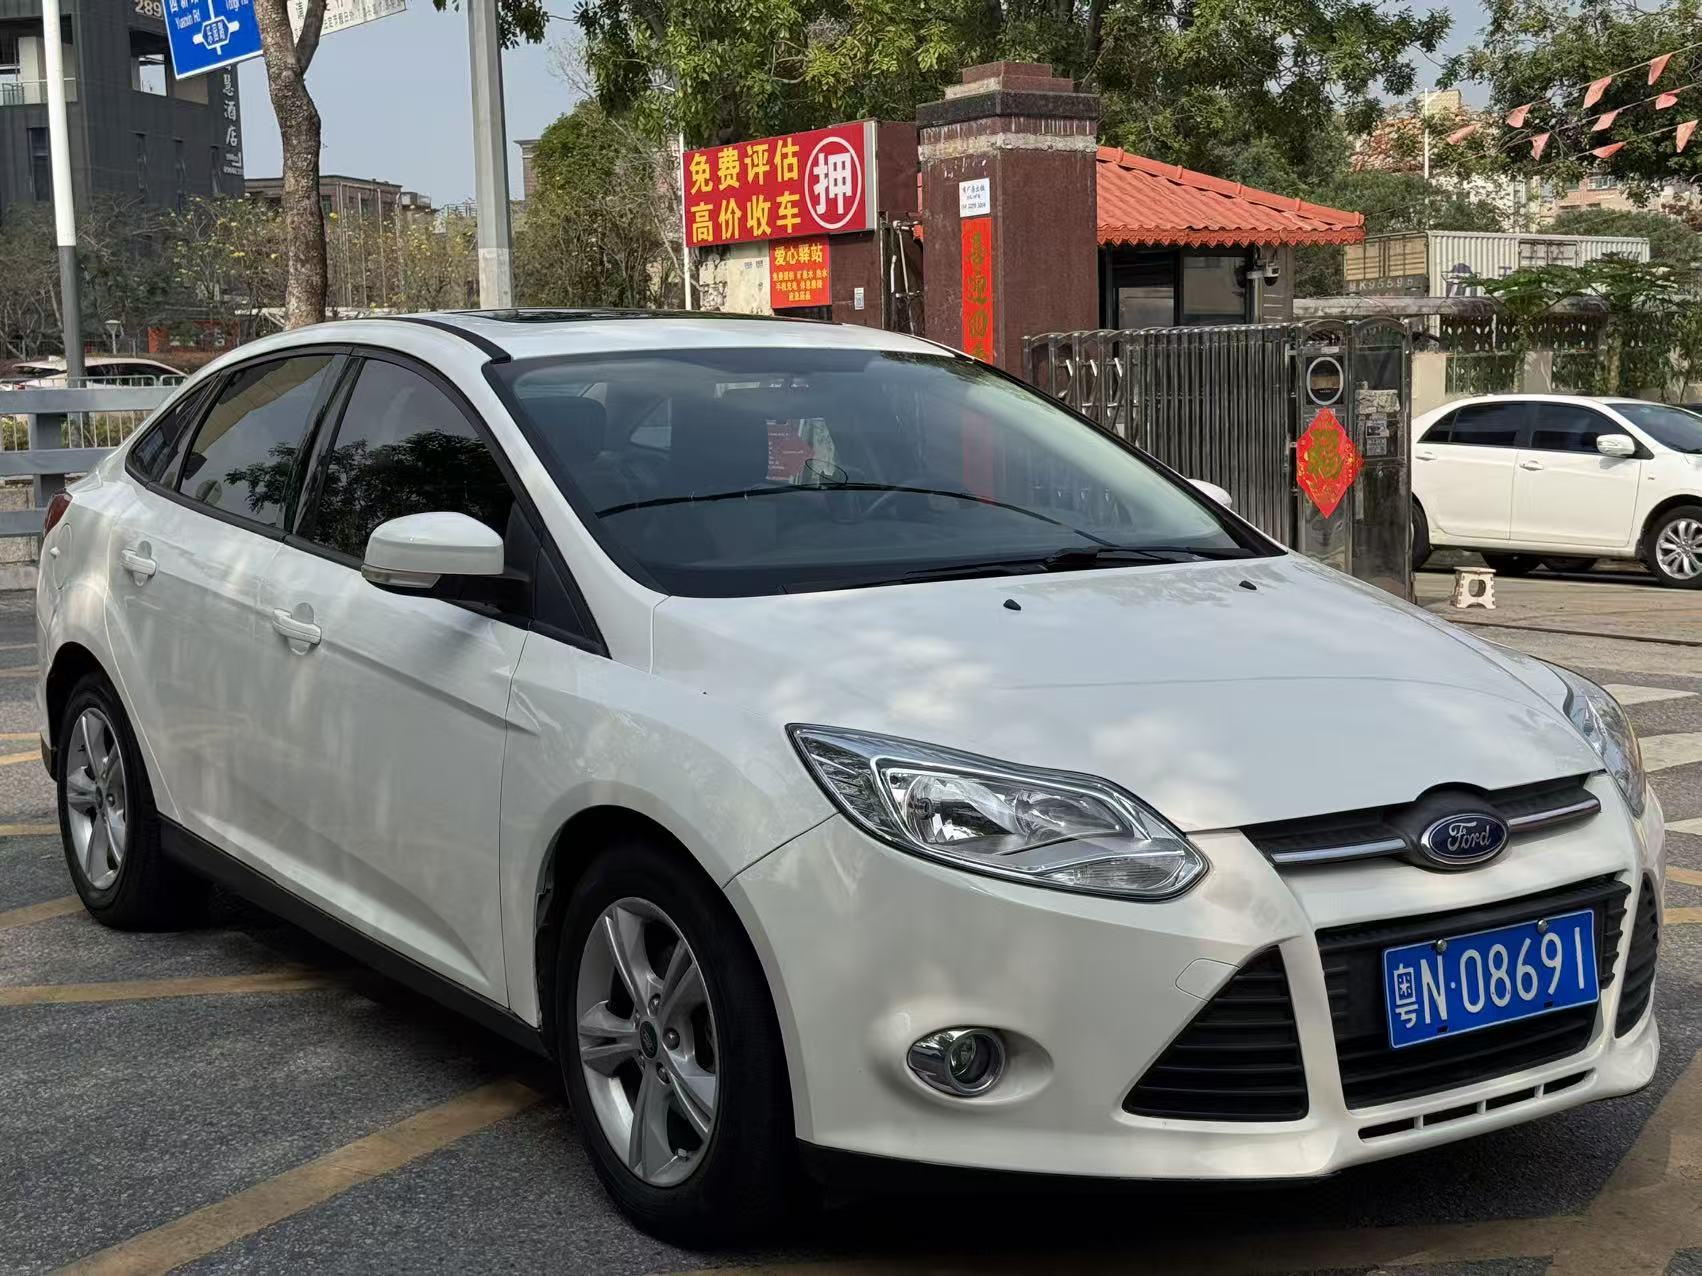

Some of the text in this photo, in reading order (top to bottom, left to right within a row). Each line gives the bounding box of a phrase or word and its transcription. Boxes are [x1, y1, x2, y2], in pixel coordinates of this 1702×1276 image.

[135, 0, 162, 16] 289
[689, 137, 800, 195] 免费评估
[813, 152, 853, 215] 押
[690, 190, 801, 243] 高价收车
[774, 243, 823, 266] 爱心驿站
[1448, 821, 1491, 851] Ford
